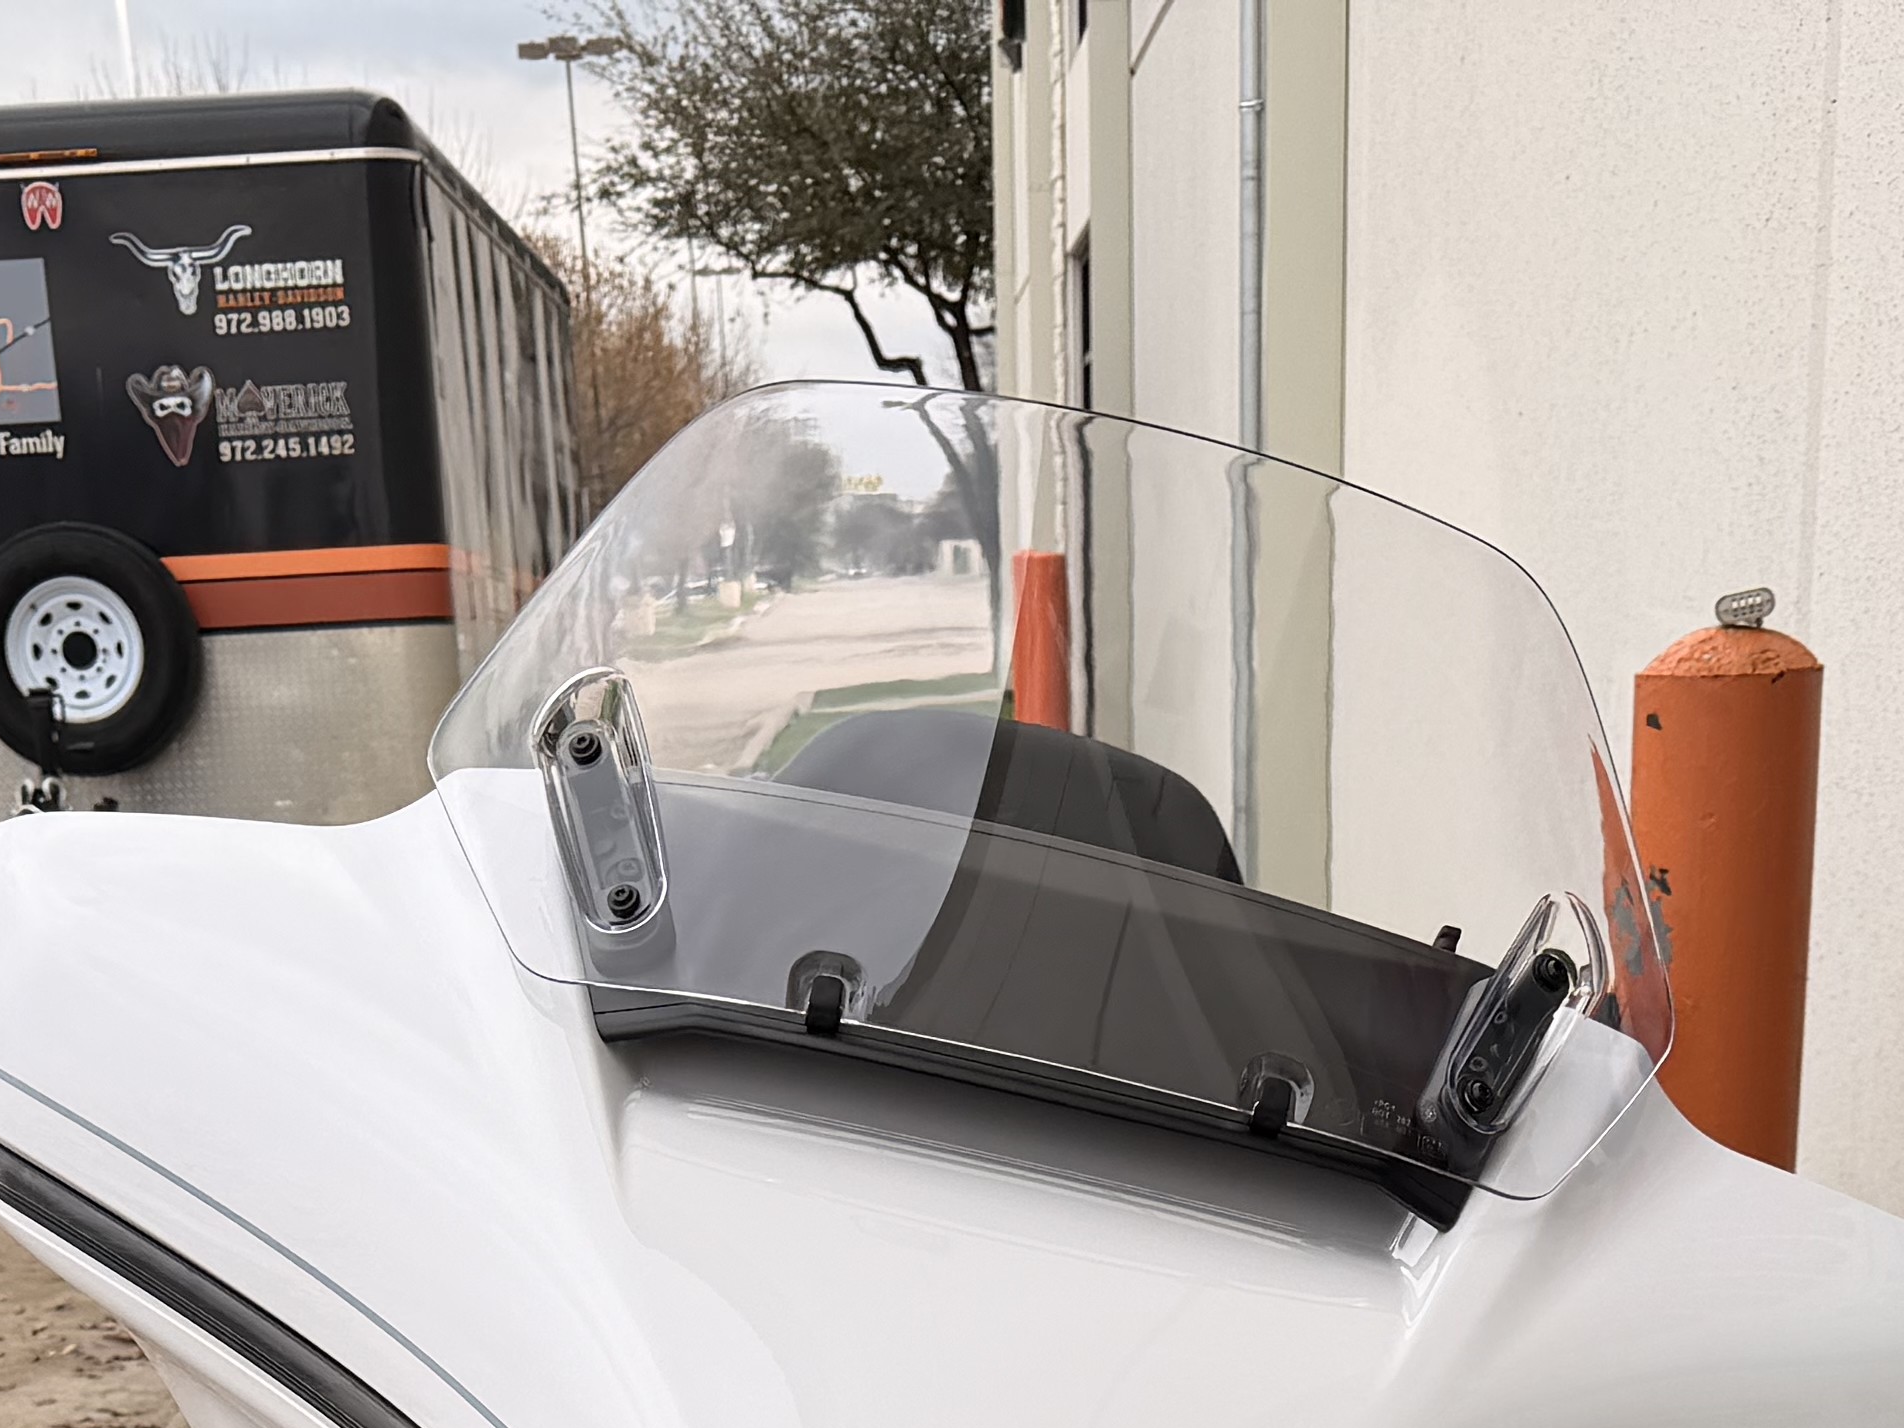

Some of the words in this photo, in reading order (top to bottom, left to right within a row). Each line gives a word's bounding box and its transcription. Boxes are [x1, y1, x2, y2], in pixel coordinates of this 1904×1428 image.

[213, 259, 345, 291] LONGHORN
[214, 305, 351, 335] 972.988.1903
[218, 433, 355, 462] 972.245.1492
